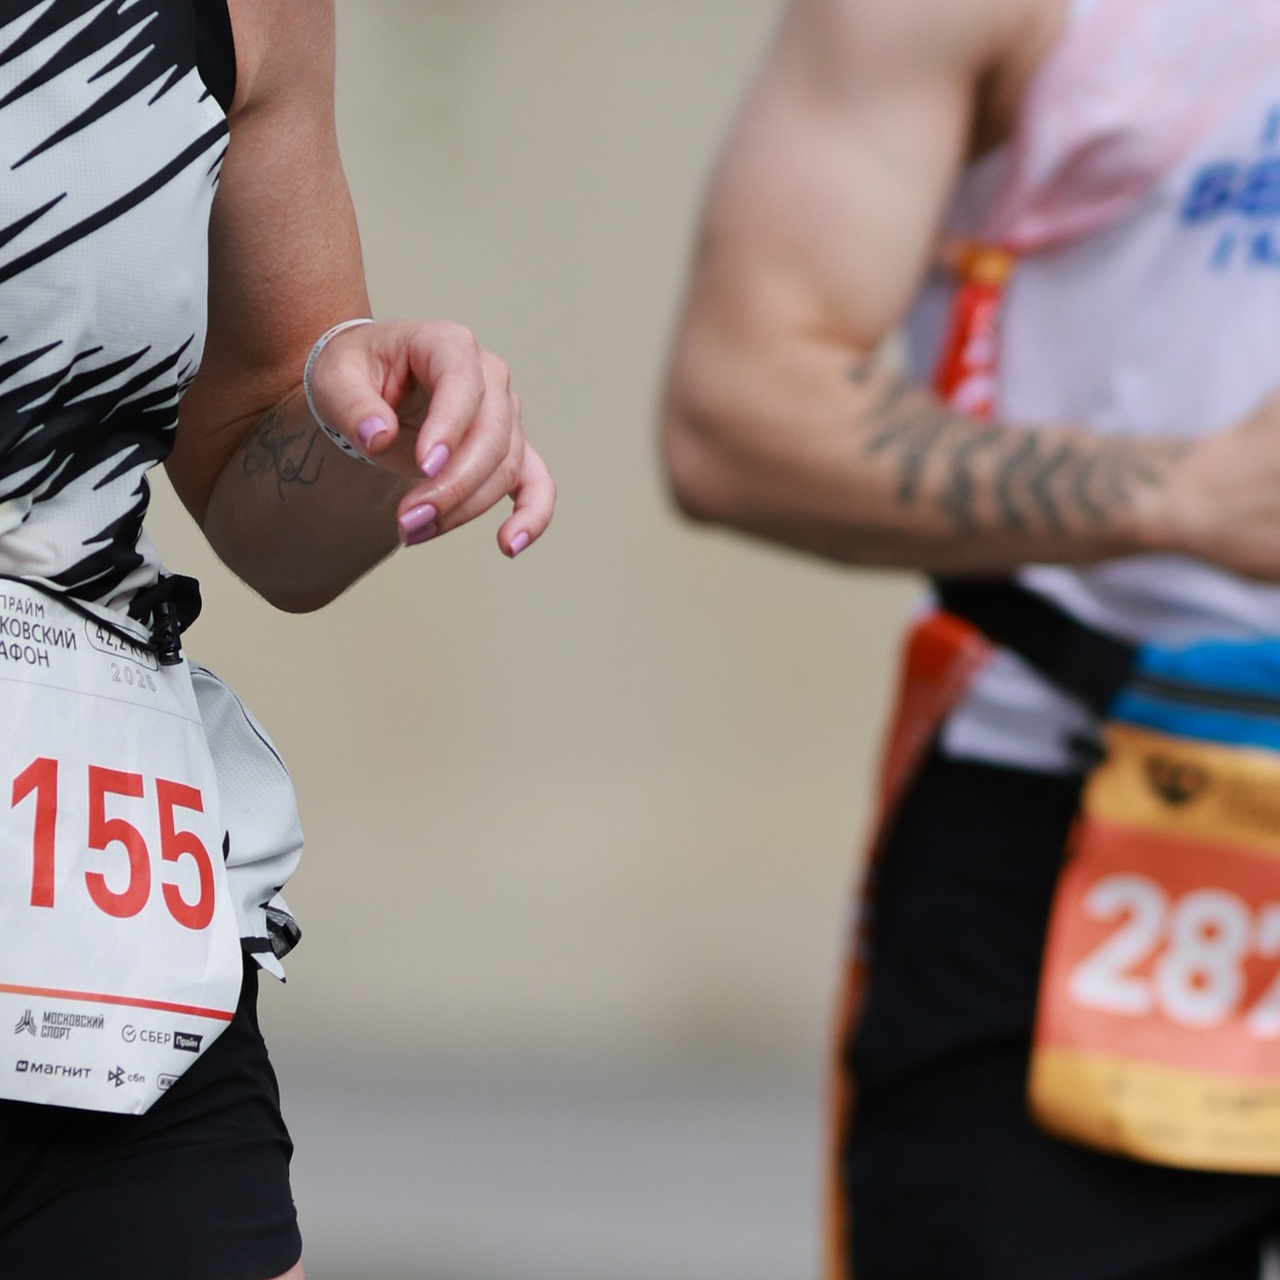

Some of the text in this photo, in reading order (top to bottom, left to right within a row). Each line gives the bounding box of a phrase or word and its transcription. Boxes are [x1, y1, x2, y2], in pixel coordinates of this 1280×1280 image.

[42, 1011, 105, 1029] МОСКОВСКИЙ
[40, 1024, 71, 1040] СПОРТ
[139, 1029, 172, 1045] СБЕР
[30, 1062, 92, 1079] магнит
[127, 1073, 146, 1083] сбп
